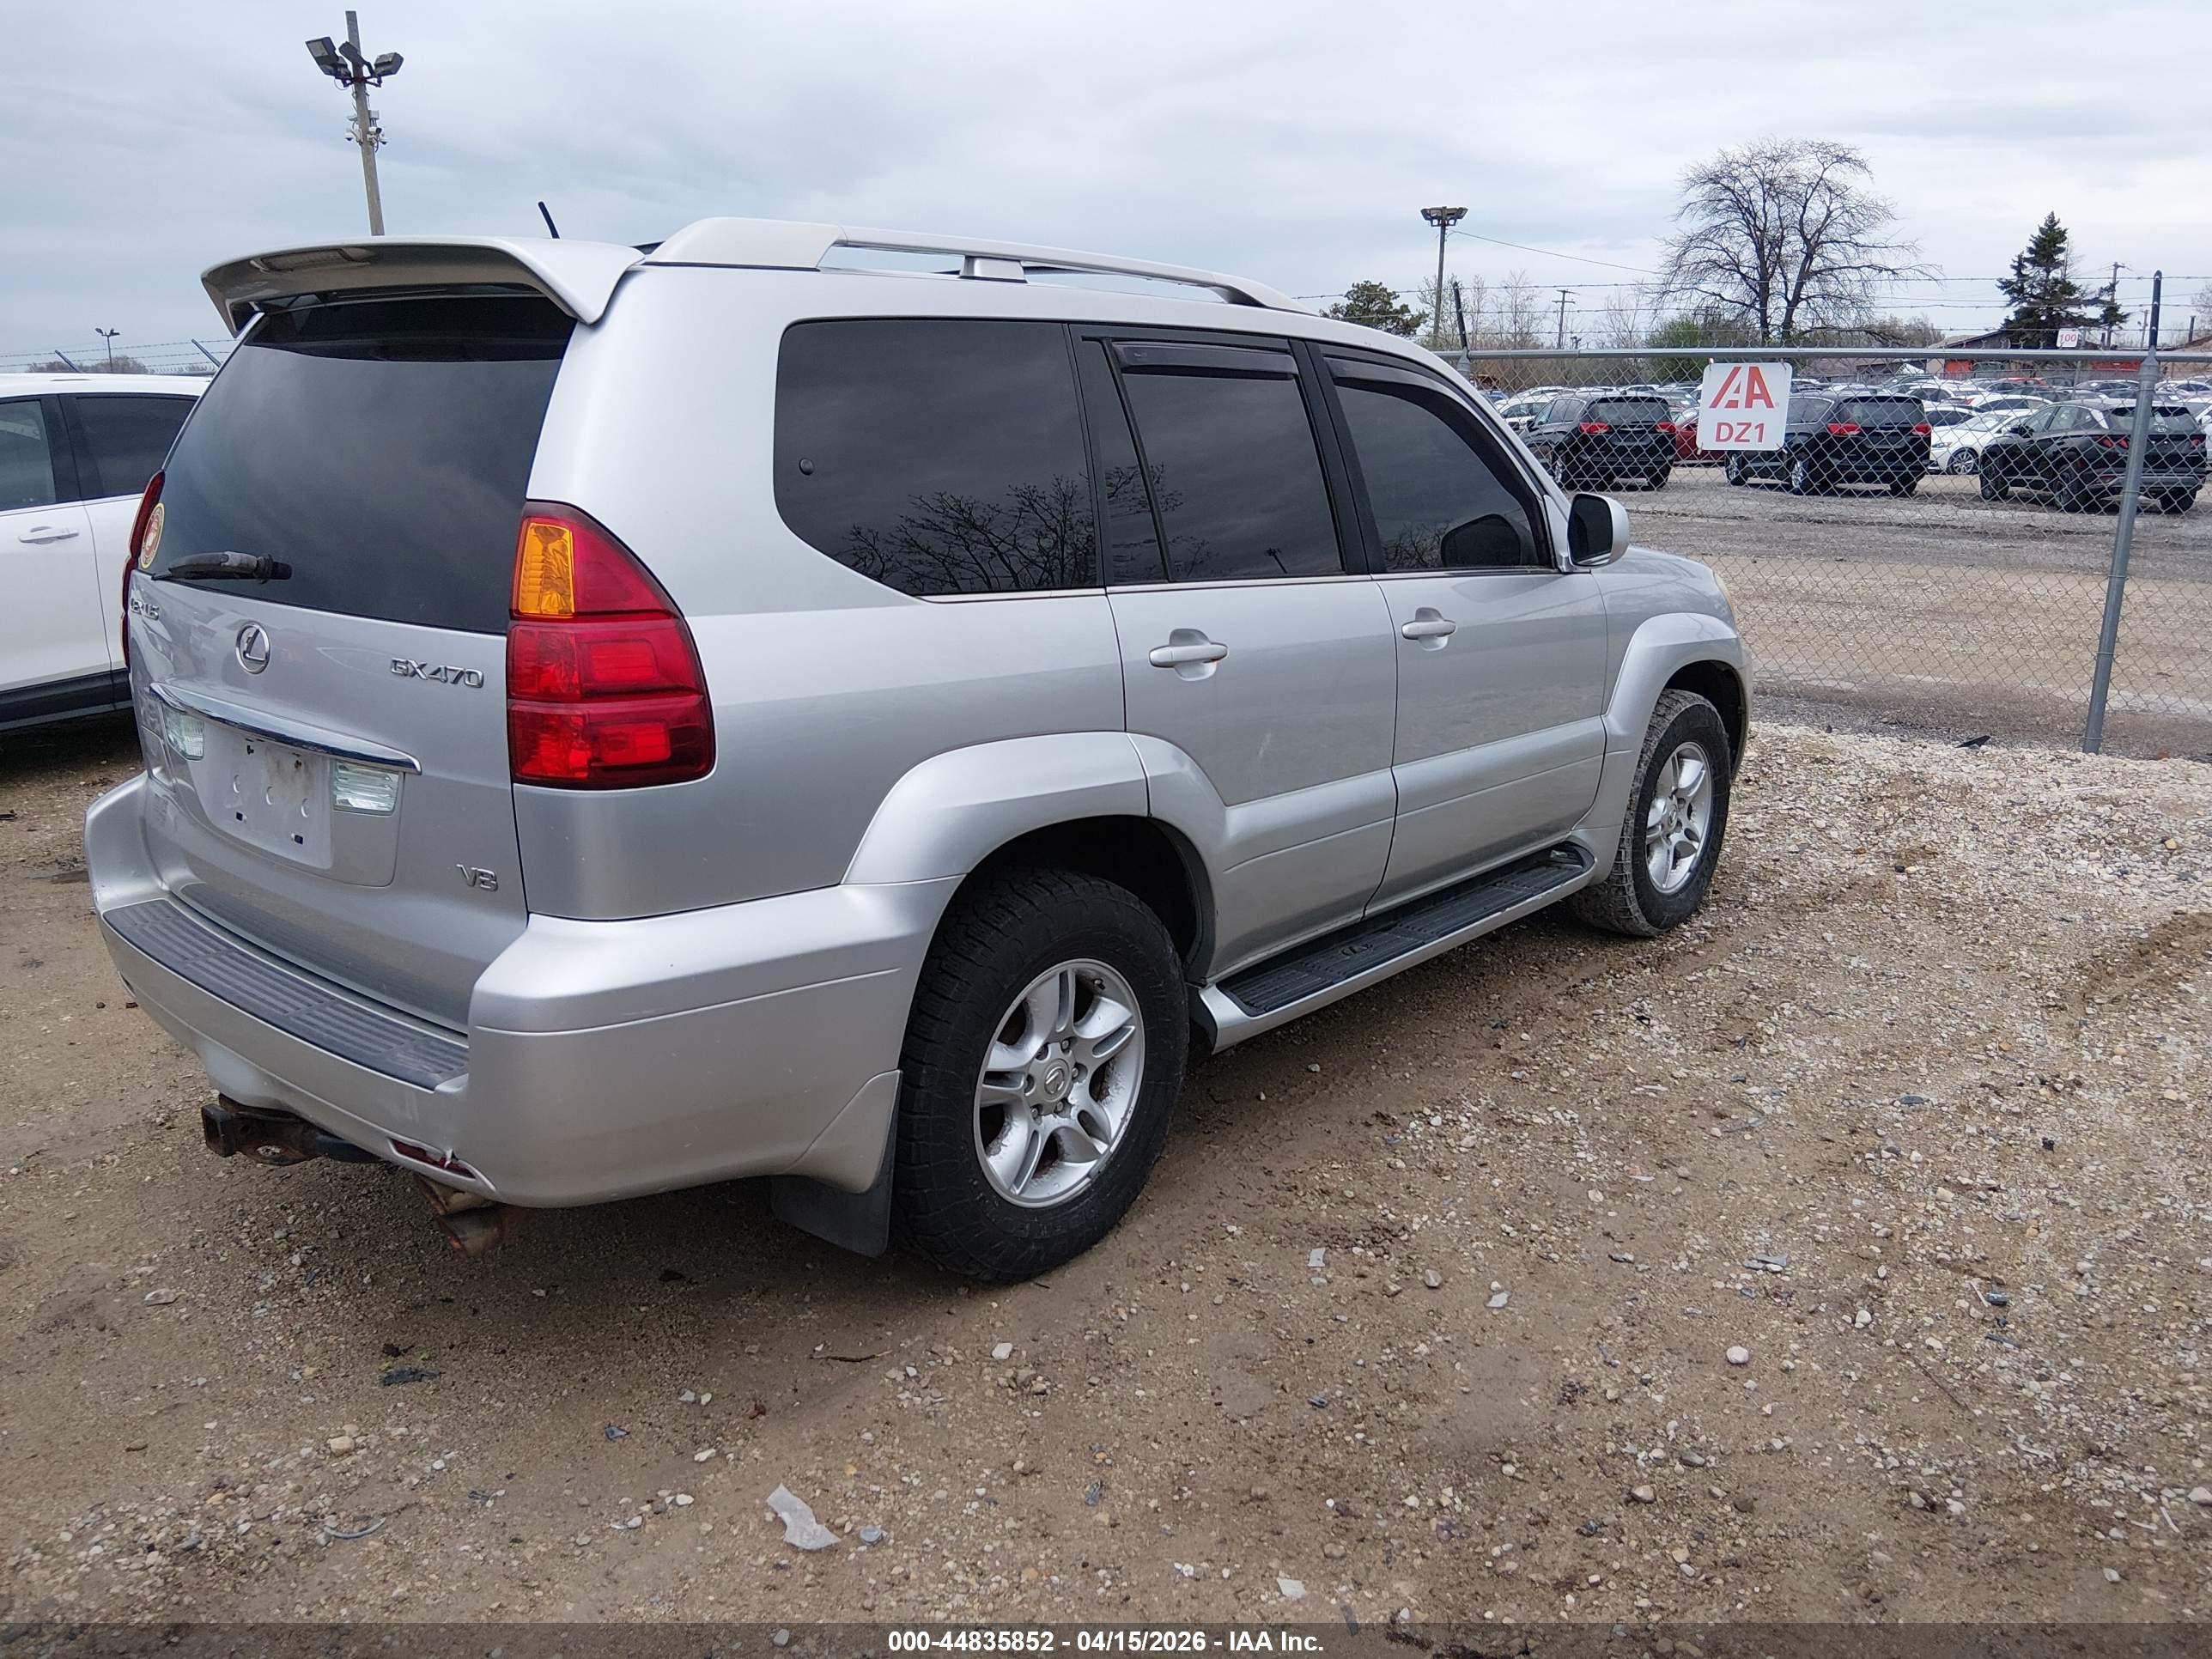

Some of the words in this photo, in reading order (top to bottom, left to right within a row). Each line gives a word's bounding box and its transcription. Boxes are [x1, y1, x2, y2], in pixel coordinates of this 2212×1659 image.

[2060, 333, 2076, 343] 100
[1715, 422, 1765, 443] DZ1
[391, 657, 484, 688] GX470
[456, 863, 499, 892] V8
